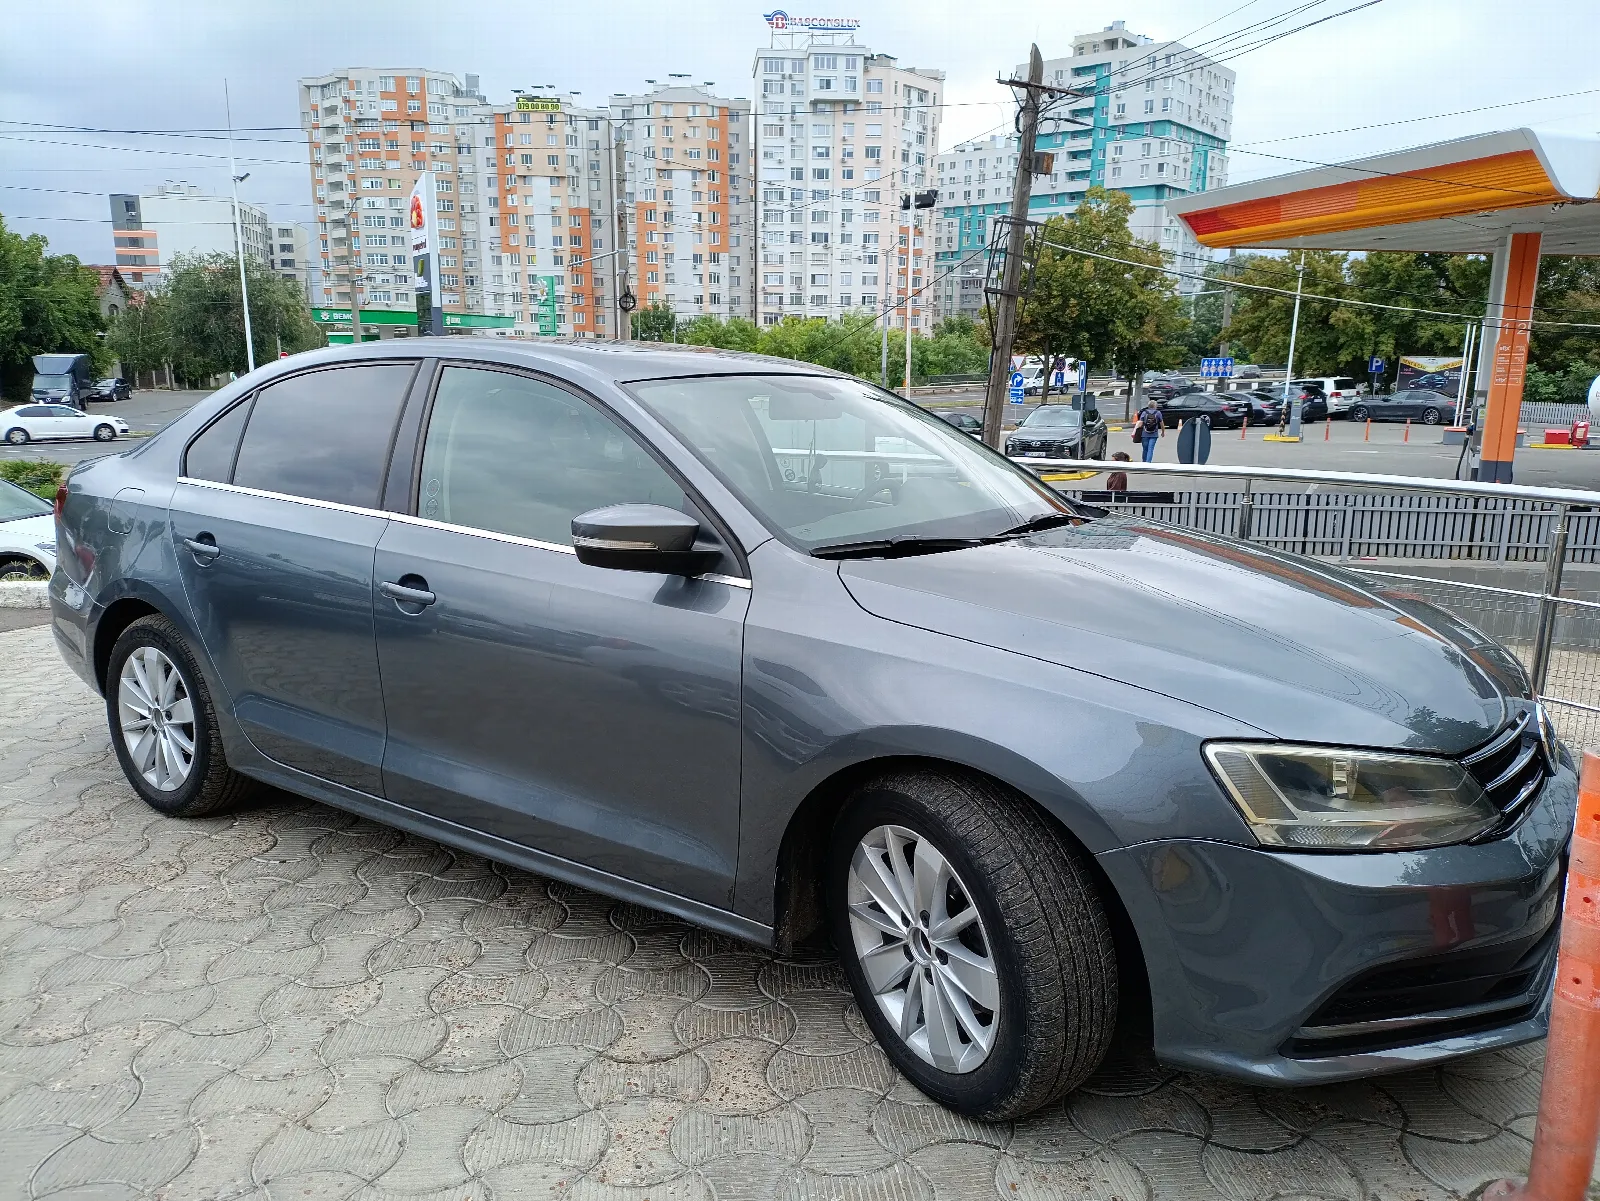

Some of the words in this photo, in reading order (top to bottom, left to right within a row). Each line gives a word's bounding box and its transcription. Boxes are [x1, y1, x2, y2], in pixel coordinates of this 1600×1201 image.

[1503, 323, 1510, 335] 1
[1516, 323, 1527, 335] 2
[1372, 357, 1382, 371] P
[1080, 364, 1085, 388] P
